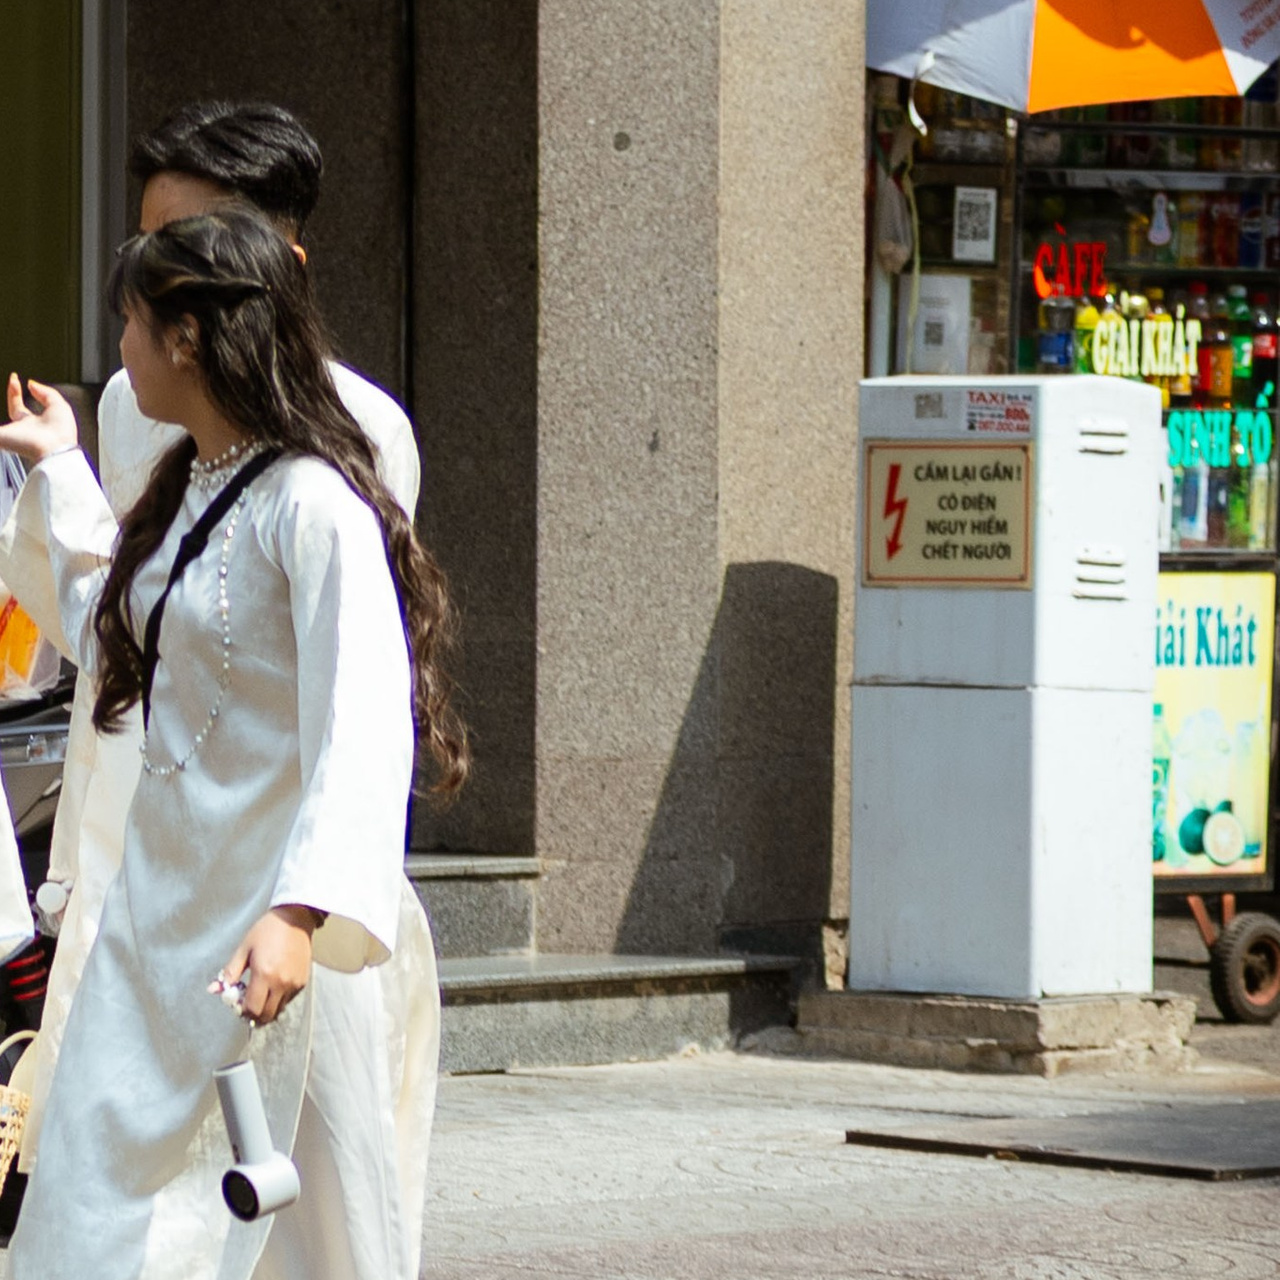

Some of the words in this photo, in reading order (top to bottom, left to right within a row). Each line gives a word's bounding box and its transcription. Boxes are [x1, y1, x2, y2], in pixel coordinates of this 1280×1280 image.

[967, 390, 1006, 405] TAXI
[1167, 410, 1232, 468] SINH
[1235, 380, 1272, 468] TỐ
[938, 491, 959, 511] CÓ
[926, 519, 967, 535] NGUY
[1195, 604, 1257, 667] Khát
